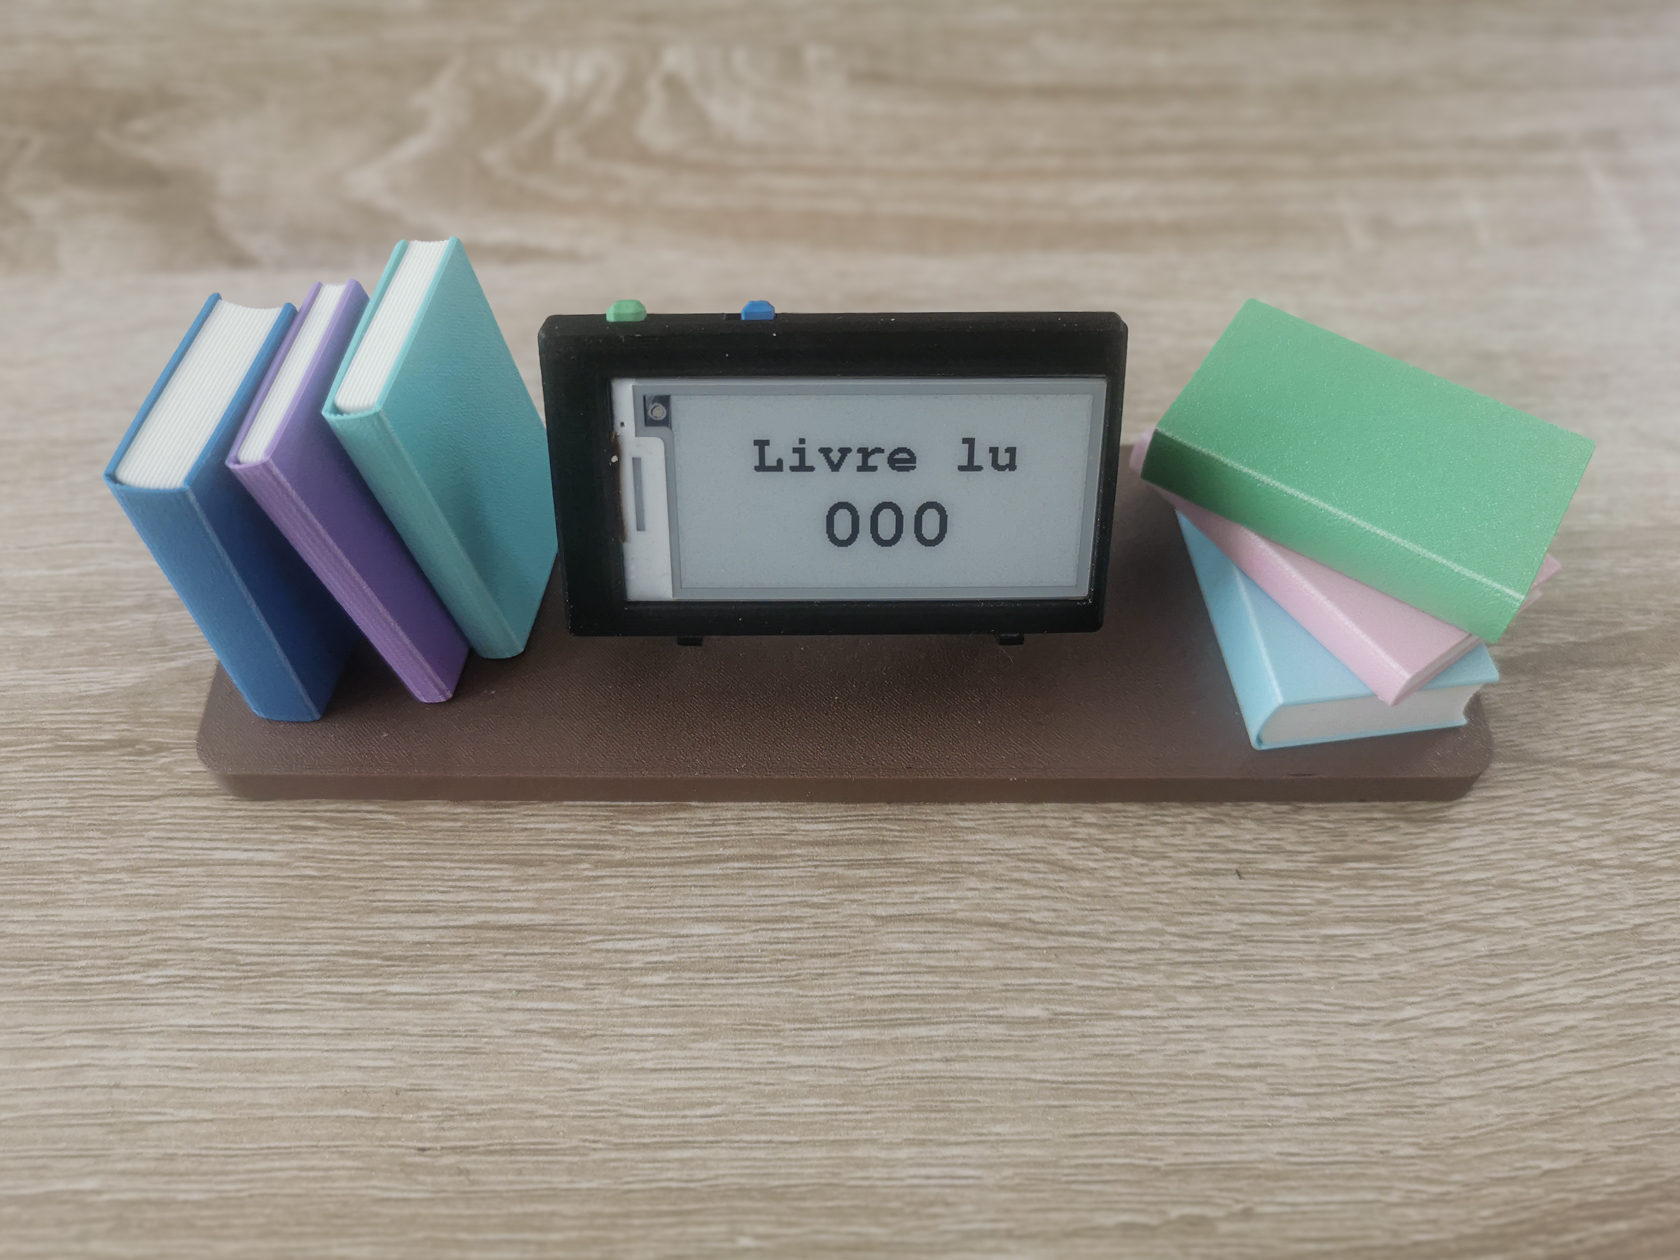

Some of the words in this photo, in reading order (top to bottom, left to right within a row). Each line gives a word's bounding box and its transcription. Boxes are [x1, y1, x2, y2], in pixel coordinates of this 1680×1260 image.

[753, 437, 917, 473] Livre
[957, 436, 1018, 473] lu
[825, 500, 949, 548] 000
